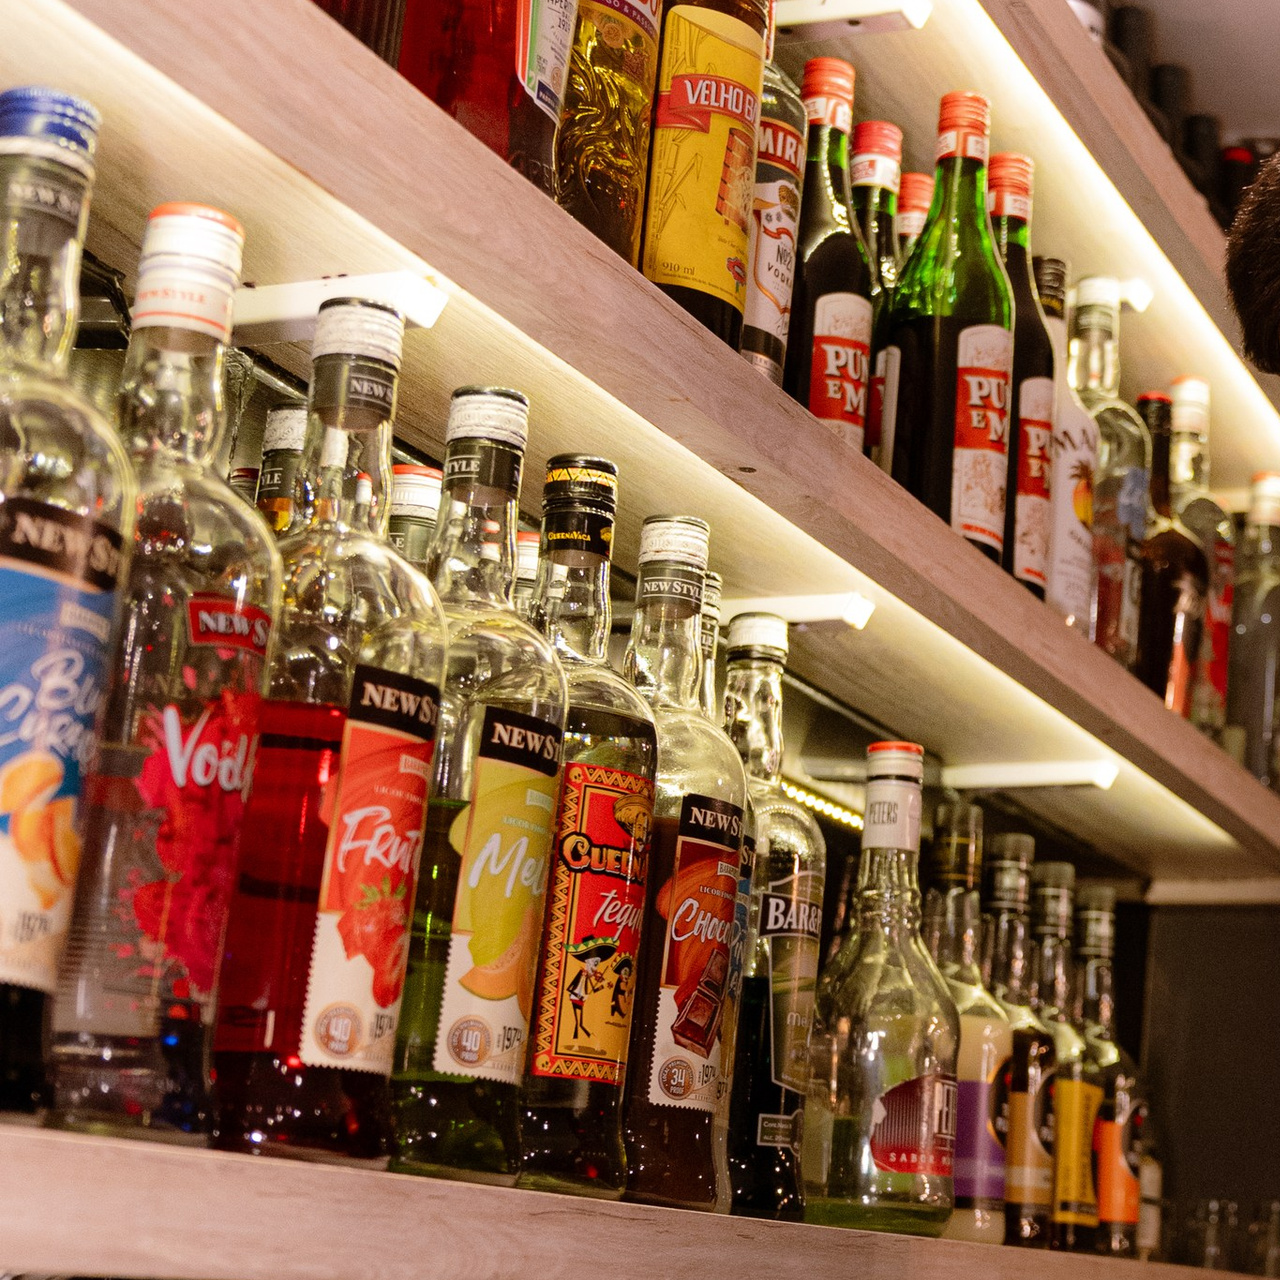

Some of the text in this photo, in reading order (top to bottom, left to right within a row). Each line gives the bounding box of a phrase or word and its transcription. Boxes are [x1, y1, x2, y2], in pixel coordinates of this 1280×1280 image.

[684, 79, 744, 114] VELHO
[662, 261, 695, 276] 910 ml
[349, 379, 388, 398] NEW
[643, 582, 672, 593] NEW
[360, 681, 421, 718] NEW
[491, 722, 545, 755] NEW
[689, 806, 732, 832] NEW
[462, 1029, 480, 1052] 40
[670, 1068, 686, 1087] 34
